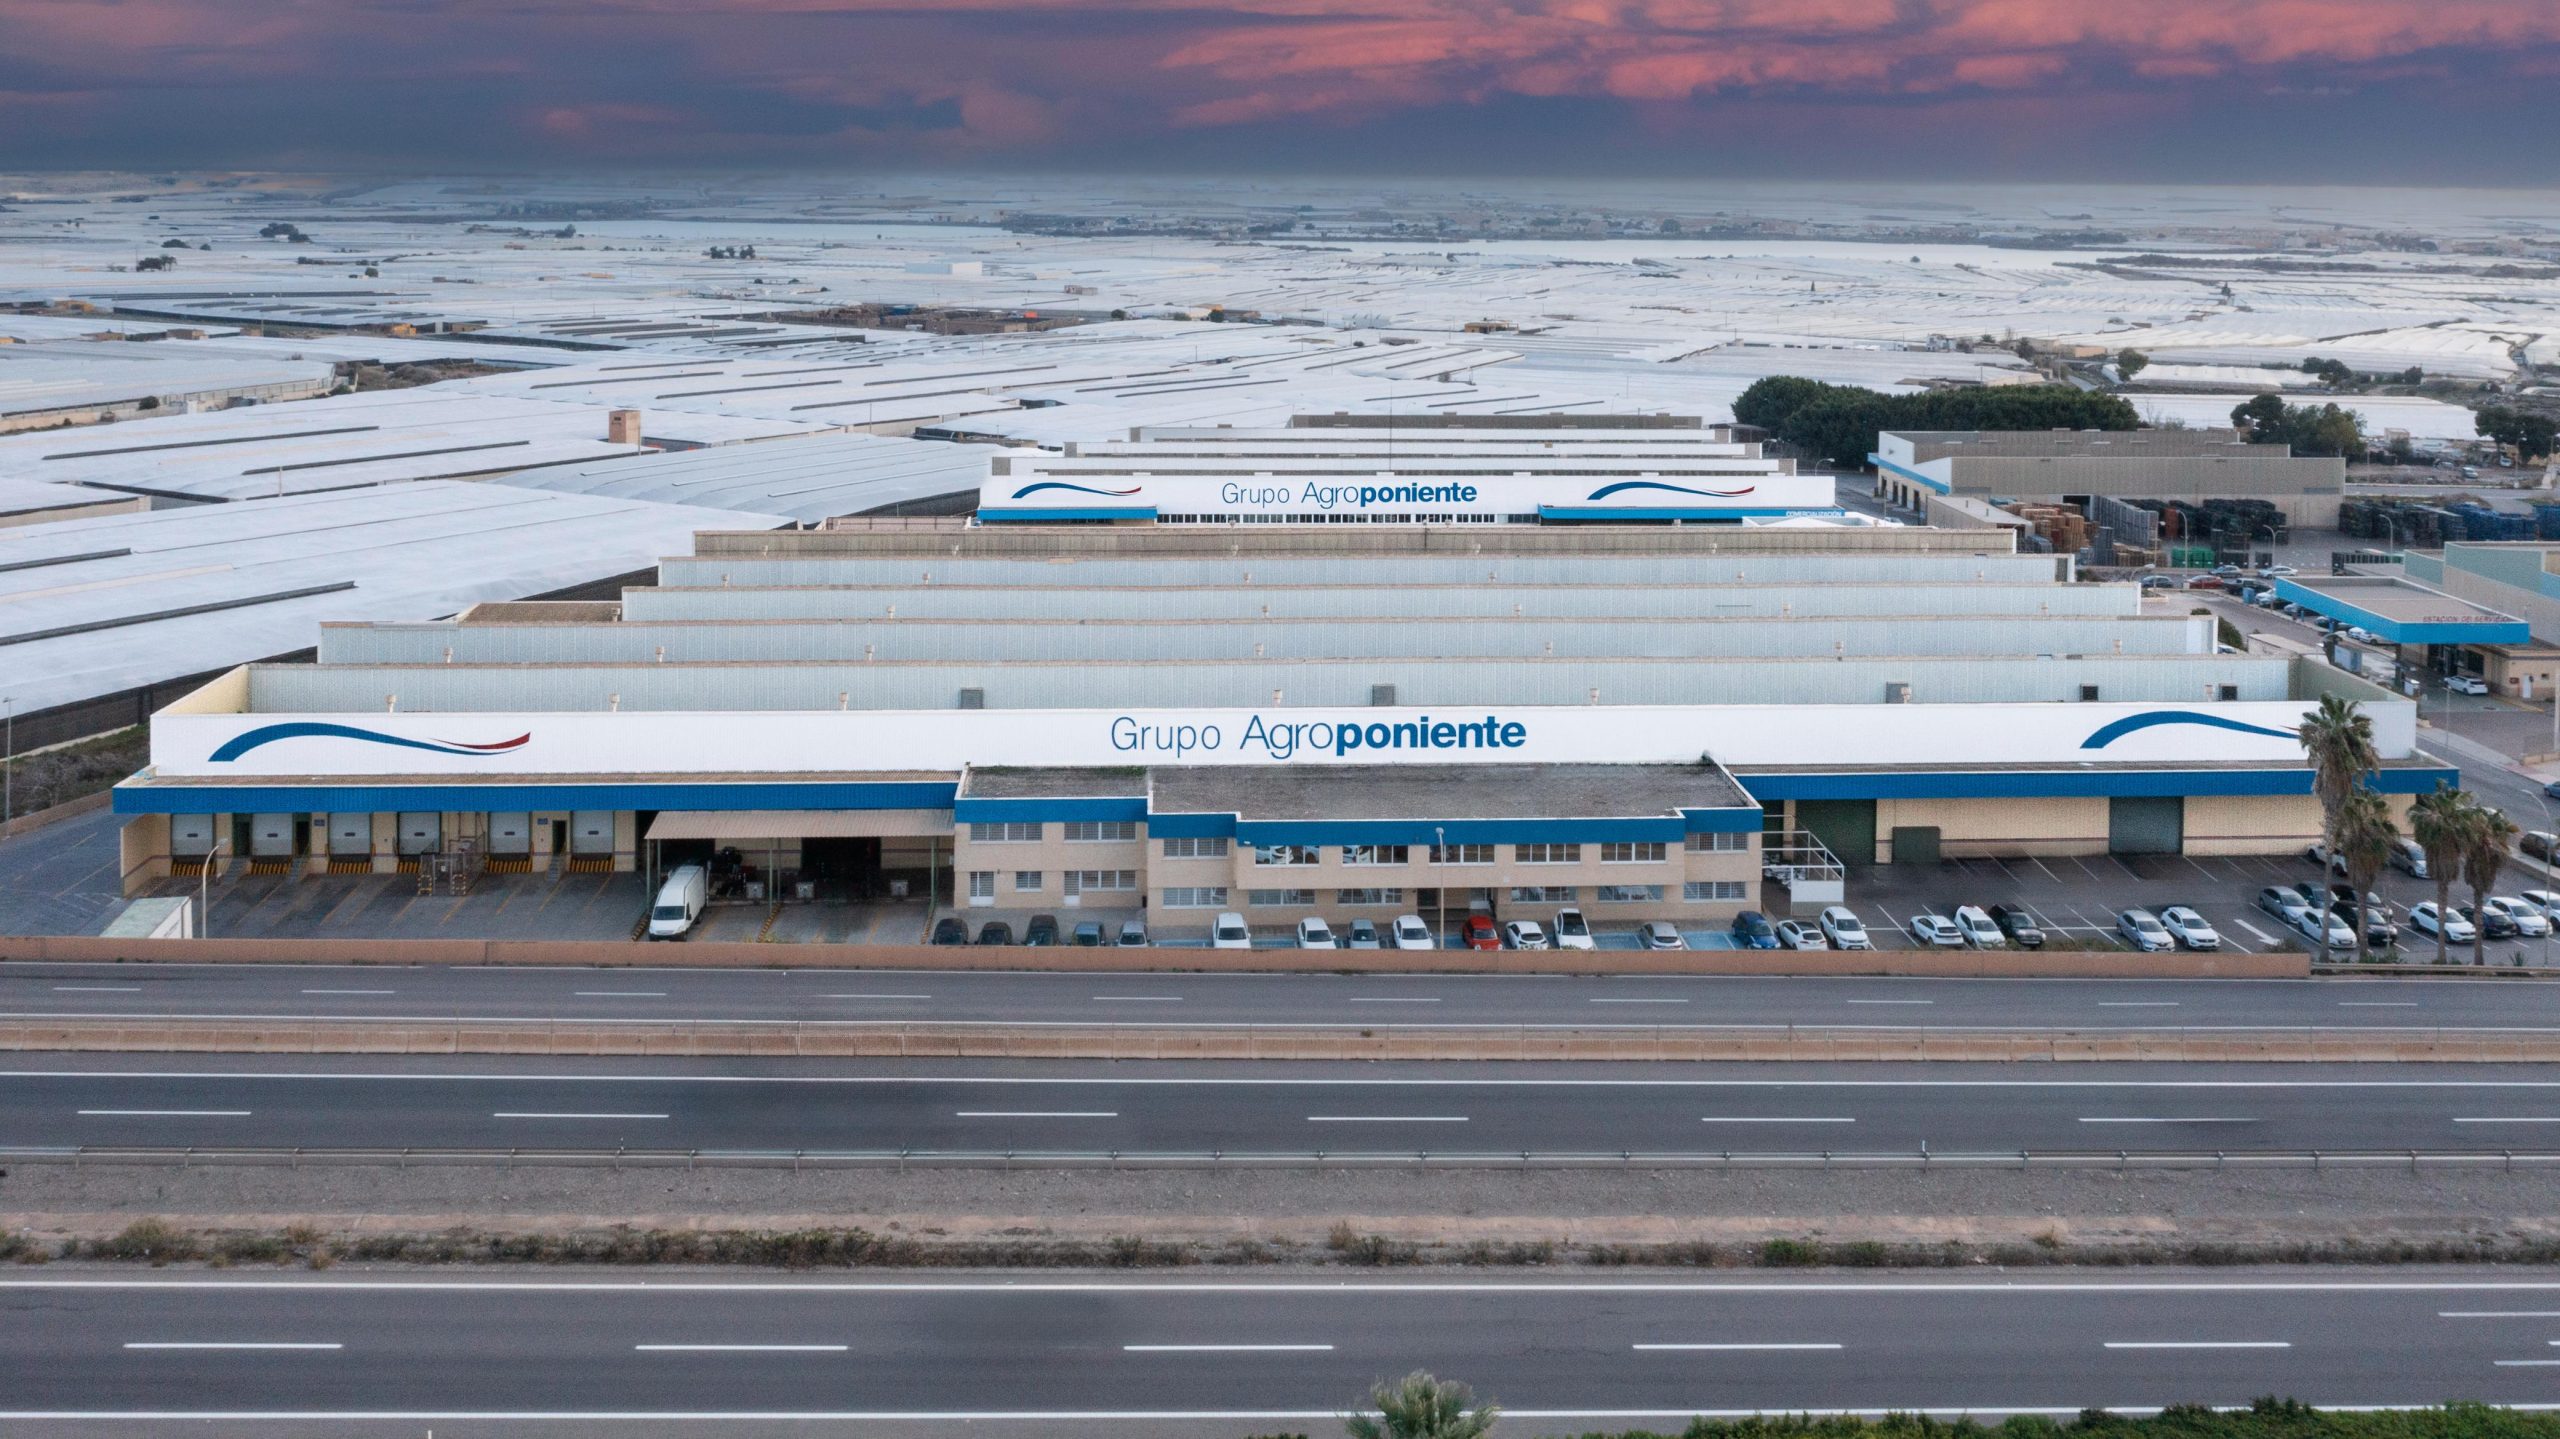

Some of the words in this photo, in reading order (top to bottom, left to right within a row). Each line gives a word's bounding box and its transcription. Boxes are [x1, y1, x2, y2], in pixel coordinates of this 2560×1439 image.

[1221, 482, 1289, 508] Grupo
[1300, 481, 1478, 509] Agroponiente
[1111, 716, 1220, 758] Grupo
[1239, 714, 1527, 759] Agroponiente
